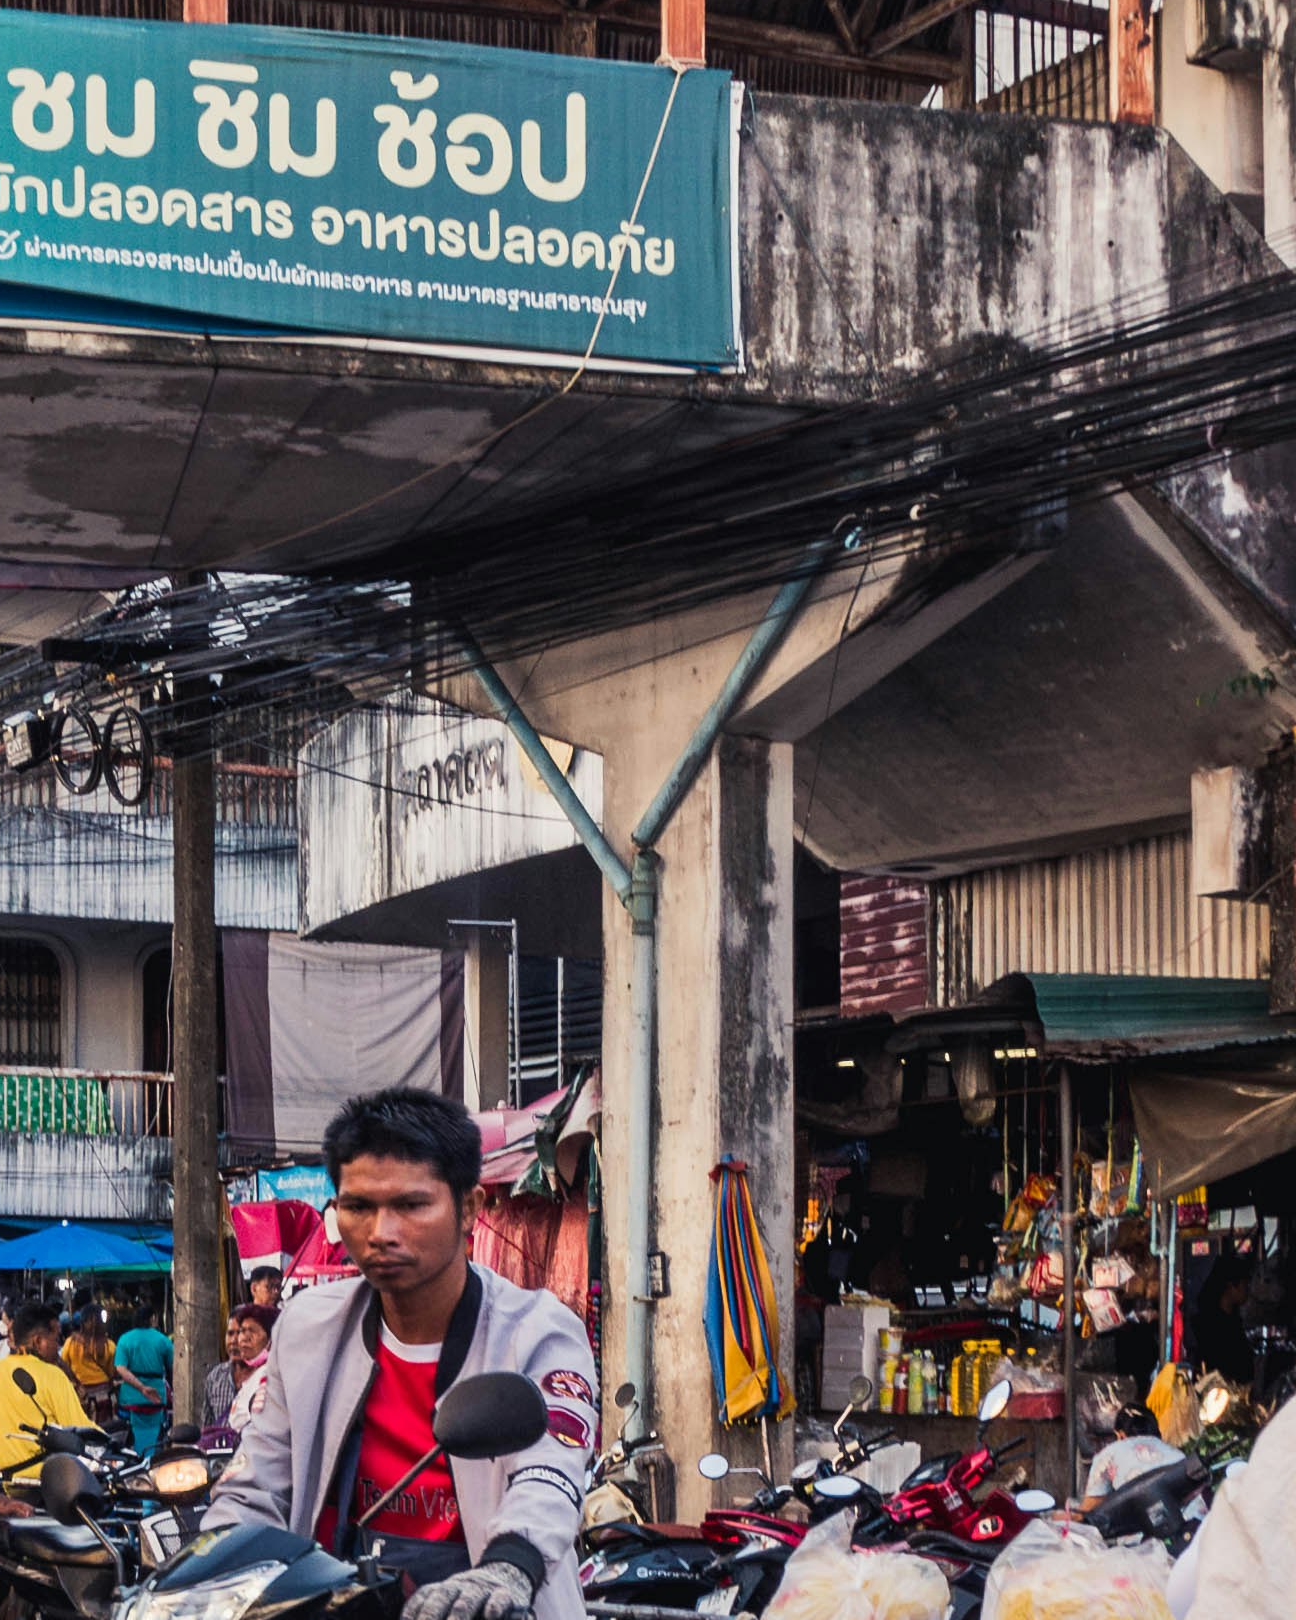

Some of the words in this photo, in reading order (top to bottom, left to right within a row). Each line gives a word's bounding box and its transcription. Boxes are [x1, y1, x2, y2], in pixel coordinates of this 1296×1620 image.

[7, 68, 155, 158] ชม
[188, 60, 337, 177] ชิม
[373, 70, 587, 203] ช้อป
[311, 205, 675, 276] อาหารปลอดภัย
